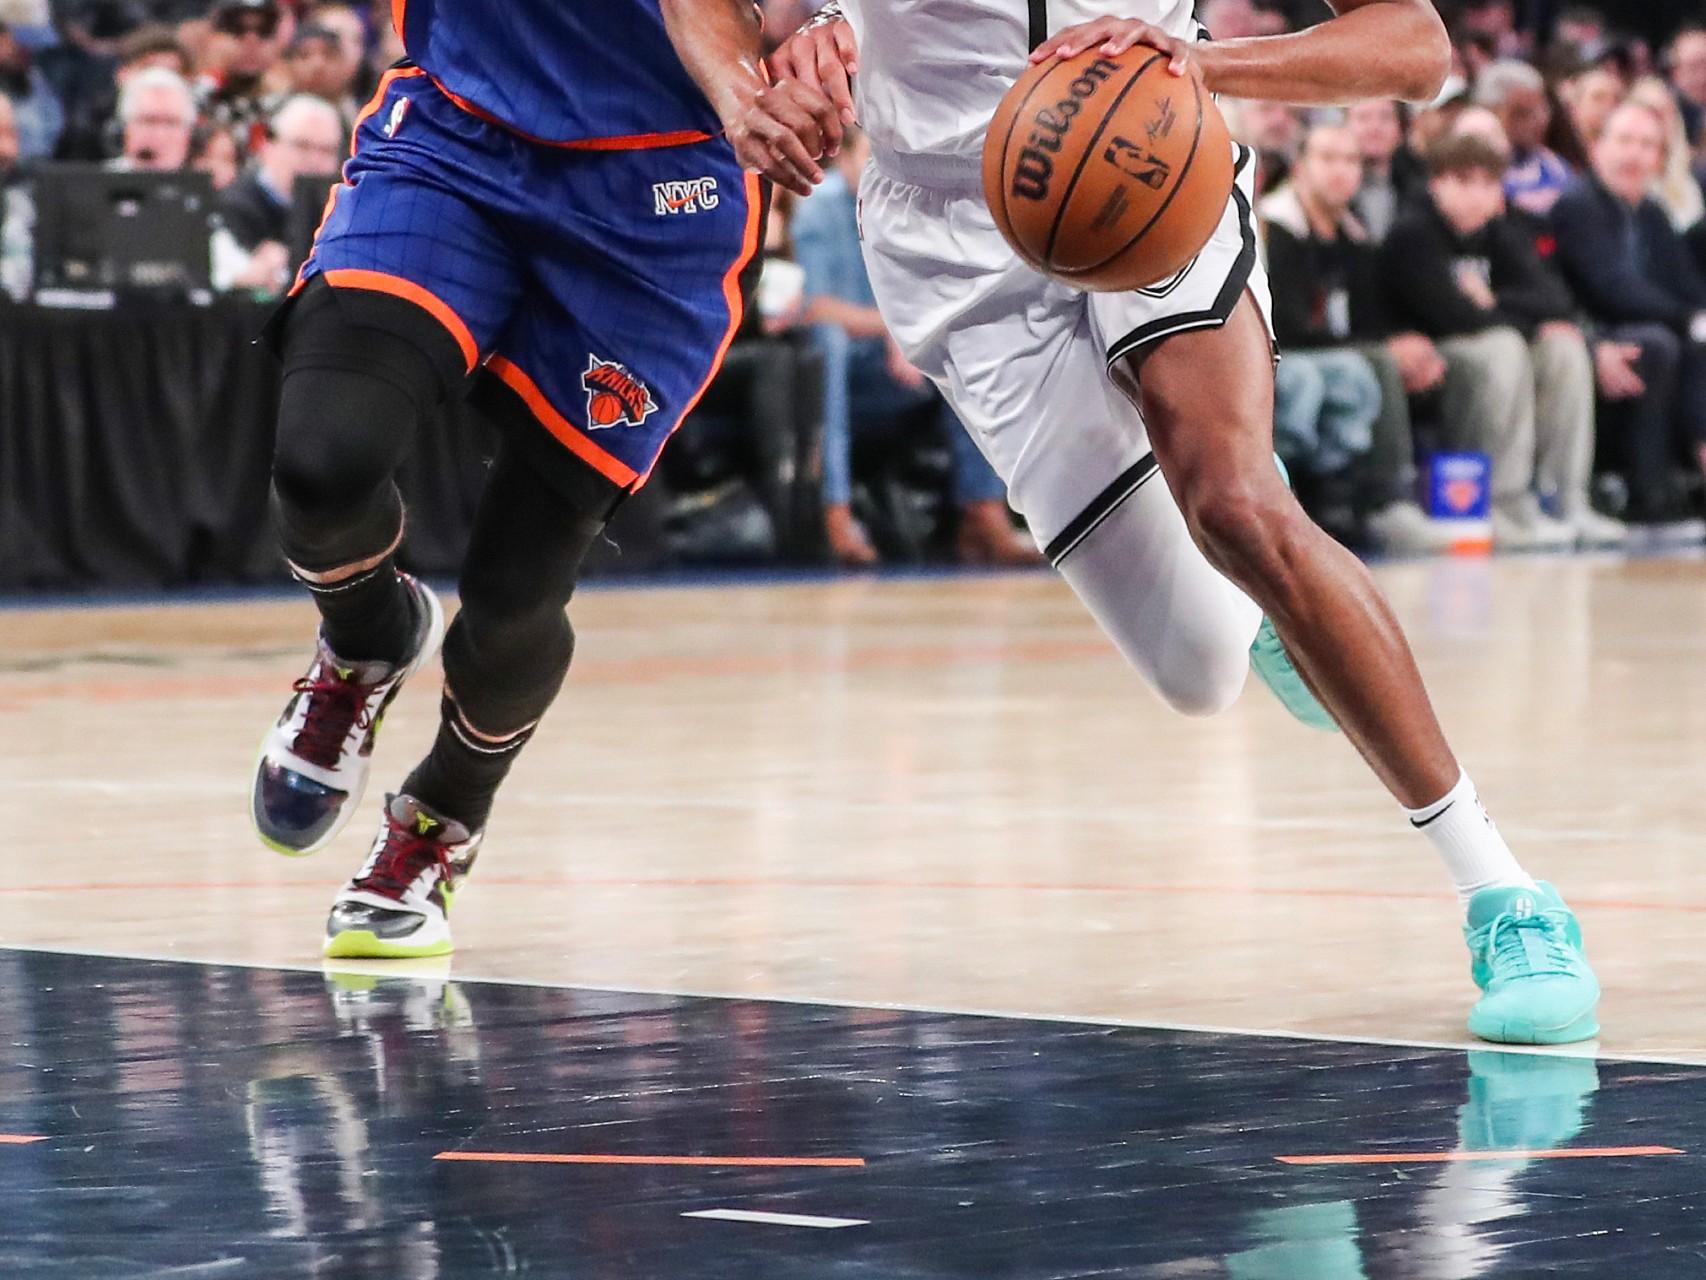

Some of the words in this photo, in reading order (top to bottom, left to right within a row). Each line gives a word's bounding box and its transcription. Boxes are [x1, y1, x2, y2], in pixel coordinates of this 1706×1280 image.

[1011, 56, 1123, 202] Wilson
[652, 176, 719, 216] NYC
[585, 365, 647, 422] KNICKS
